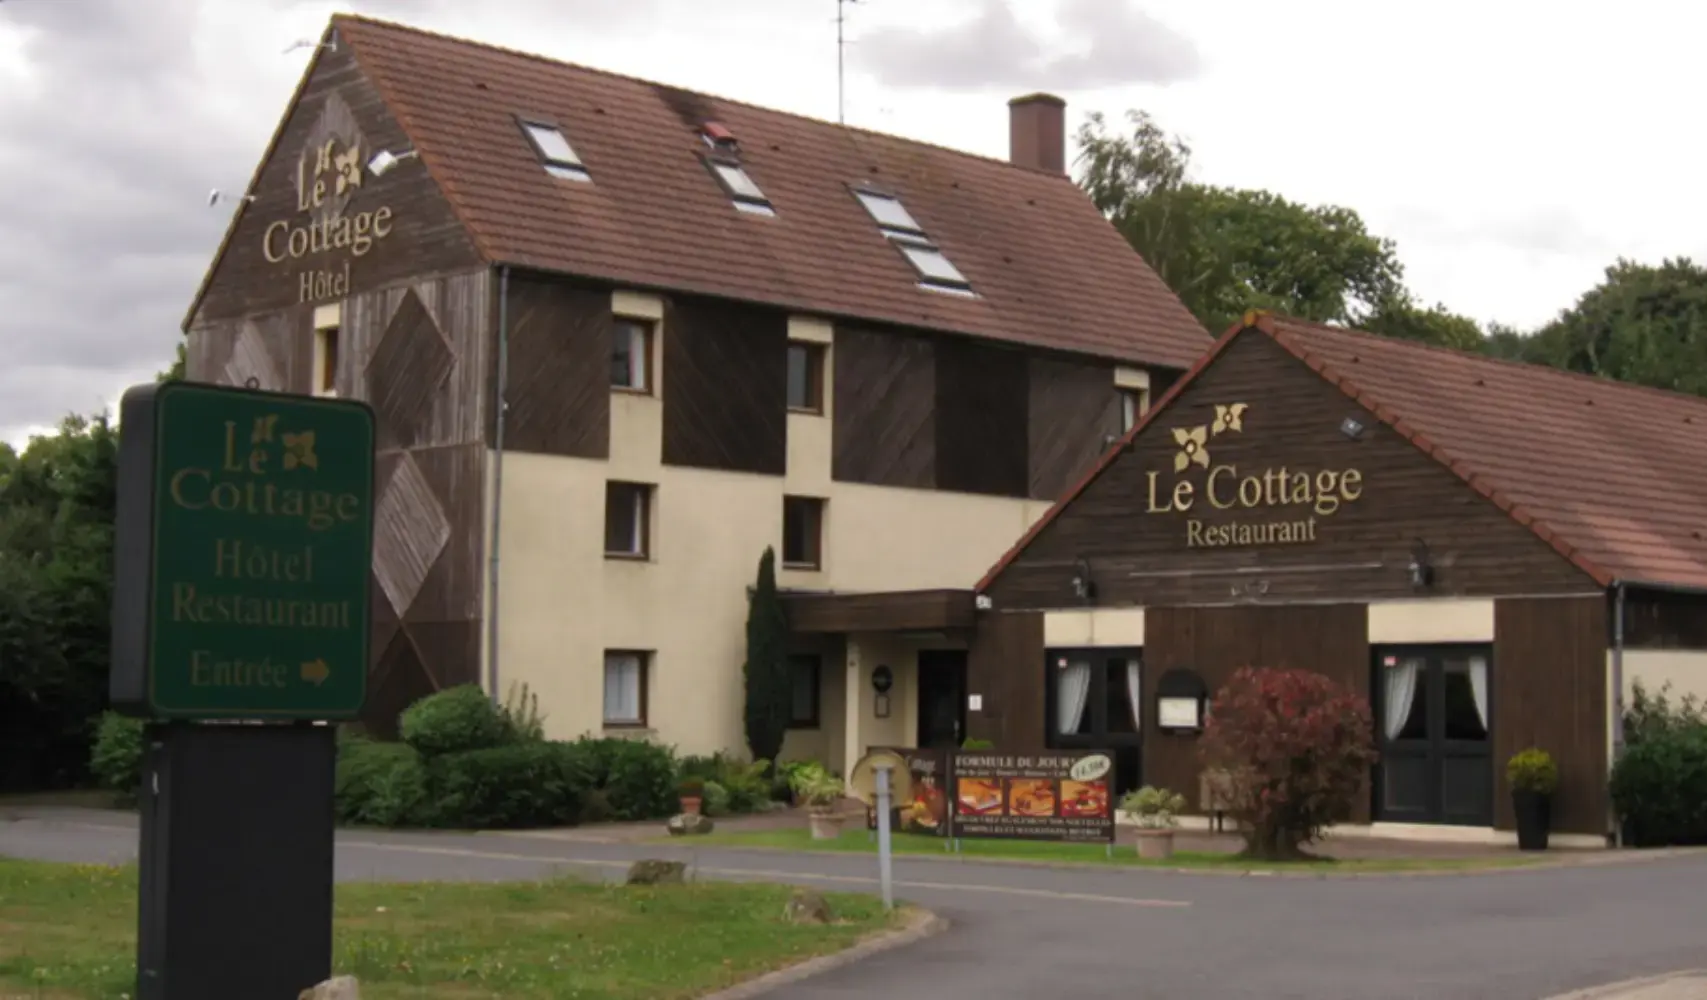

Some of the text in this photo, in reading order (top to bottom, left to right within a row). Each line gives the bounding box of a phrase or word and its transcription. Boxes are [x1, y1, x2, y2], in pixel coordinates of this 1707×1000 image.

[297, 157, 326, 212] Le
[263, 205, 393, 263] Cottage
[300, 262, 350, 303] Hôtel
[223, 420, 269, 474] Le
[170, 466, 360, 531] Cottage
[1145, 465, 1363, 515] Le Cottage
[1186, 516, 1317, 547] Restaurant
[213, 538, 314, 582] Hôtel
[172, 582, 351, 628] Restaurant
[189, 650, 288, 686] Entrée
[955, 755, 1013, 768] FORMULE
[1017, 756, 1033, 768] DU
